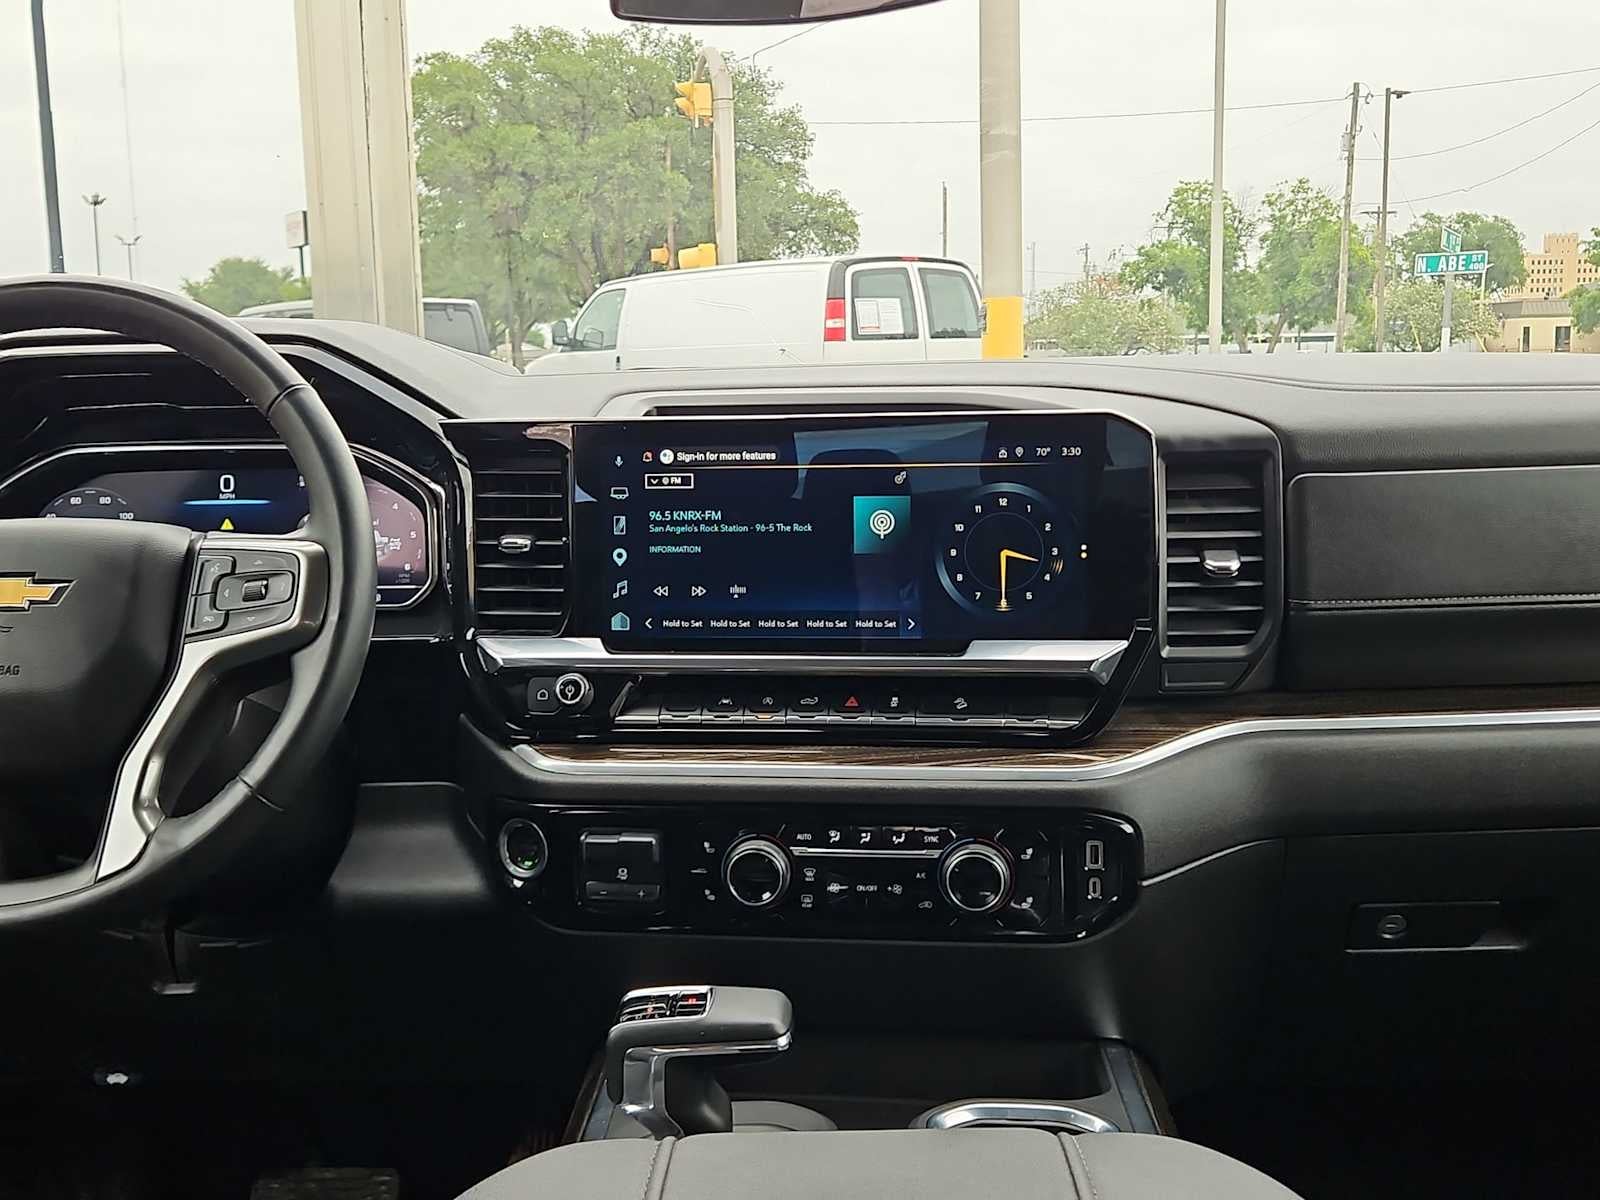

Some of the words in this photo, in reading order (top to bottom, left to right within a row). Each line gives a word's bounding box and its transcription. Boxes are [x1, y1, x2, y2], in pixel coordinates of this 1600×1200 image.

[1417, 257, 1432, 273] N.
[1437, 255, 1467, 272] ABE
[706, 451, 718, 461] for
[720, 452, 741, 461] more
[742, 450, 776, 461] features
[1061, 447, 1082, 456] 3:30
[219, 474, 235, 493] 0
[670, 477, 682, 485] FM
[70, 497, 82, 505] 60
[99, 496, 111, 505] 80
[999, 498, 1008, 506] 12
[975, 505, 982, 513] 11
[119, 512, 134, 520] 100
[649, 511, 671, 521] 96.5
[673, 511, 722, 521] KNRX-FM
[649, 524, 664, 532] San
[665, 524, 698, 535] Angelo's
[700, 524, 719, 532] Rock
[720, 524, 749, 532] Station
[755, 524, 774, 532] 96-5
[776, 524, 791, 532] The
[793, 524, 812, 532] Rock
[1045, 523, 1051, 531] 2
[410, 531, 417, 539] 5
[950, 549, 957, 557] 9
[1052, 548, 1058, 556] 3
[975, 592, 981, 600] 7
[1026, 592, 1032, 600] 5
[663, 620, 680, 628] Hold
[681, 620, 690, 628] to
[690, 620, 703, 628] Set
[710, 620, 728, 628] Hold
[729, 620, 738, 628] to
[738, 620, 751, 628] Set
[758, 620, 776, 628] Hold
[777, 620, 786, 628] to
[786, 620, 799, 628] Set
[806, 620, 824, 628] Hold
[825, 620, 834, 628] to
[834, 620, 847, 628] Set
[855, 620, 874, 628] Hold
[874, 620, 883, 628] to
[884, 620, 897, 628] Set
[796, 833, 812, 841] AUTO
